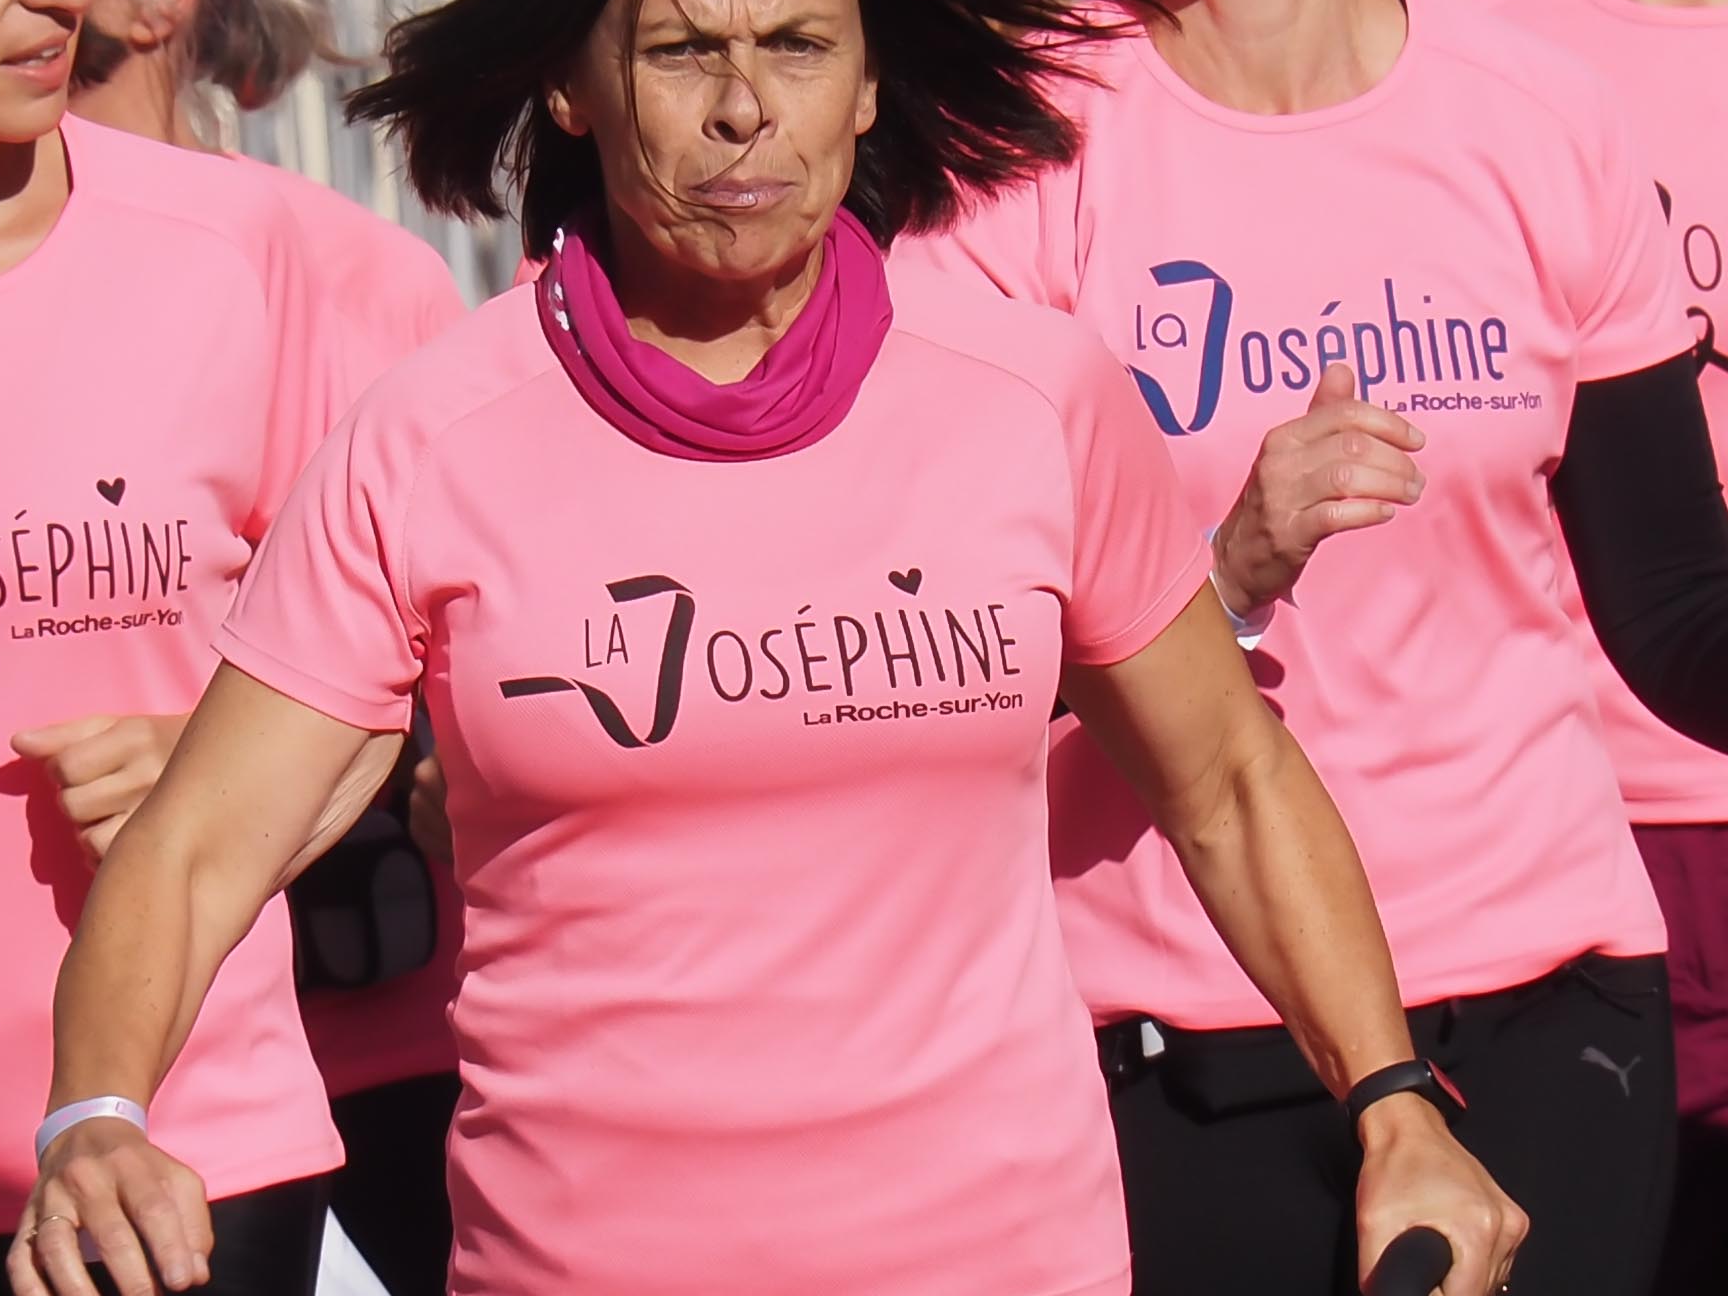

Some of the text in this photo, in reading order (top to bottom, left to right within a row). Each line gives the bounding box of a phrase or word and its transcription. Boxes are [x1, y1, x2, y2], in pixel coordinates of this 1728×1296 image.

[1410, 391, 1543, 412] Roche-sur-Yon
[11, 623, 35, 640] La
[498, 574, 1022, 749] LA JOSÉPHINE
[802, 690, 1024, 727] La Roche-sur-Yon
